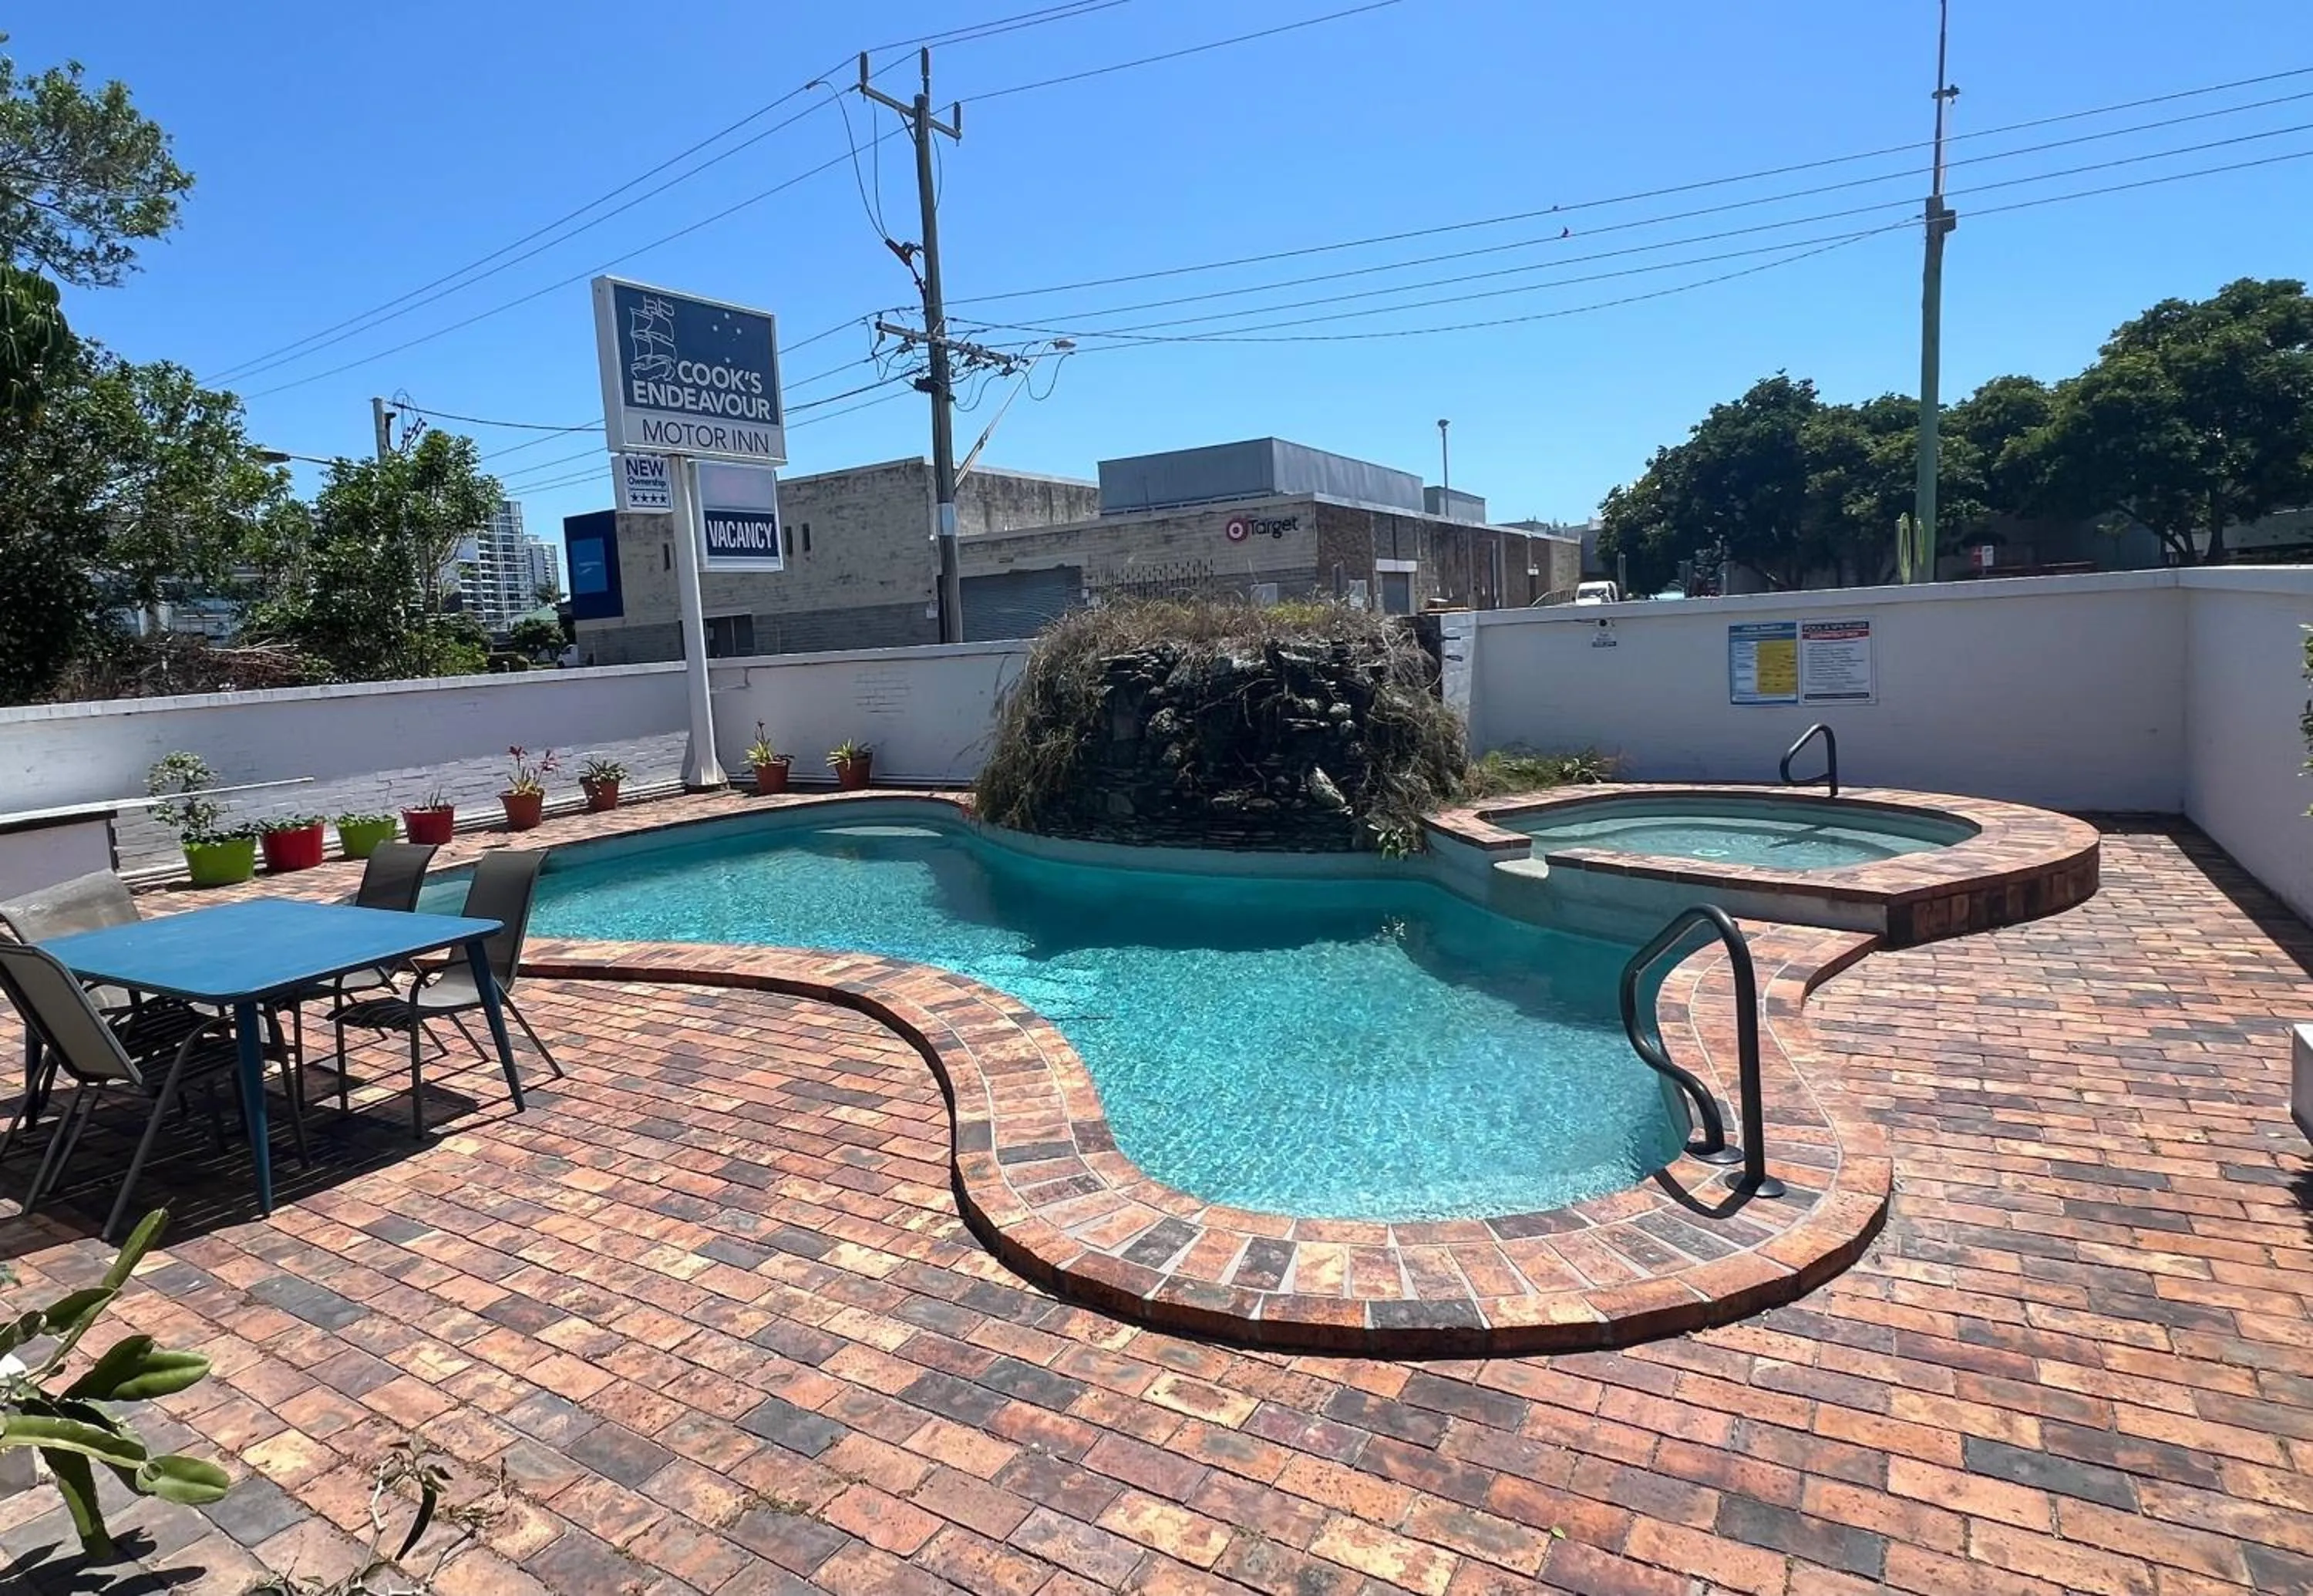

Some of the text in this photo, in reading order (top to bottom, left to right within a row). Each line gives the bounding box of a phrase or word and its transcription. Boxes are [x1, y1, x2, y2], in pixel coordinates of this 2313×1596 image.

[677, 360, 763, 394] COOK'S
[632, 379, 771, 420] ENDEAVOUR
[642, 419, 769, 453] MOTOR INN
[625, 458, 664, 476] NEW
[628, 476, 667, 488] Ownership
[707, 520, 773, 549] VACANCY
[1247, 515, 1298, 539] Target
